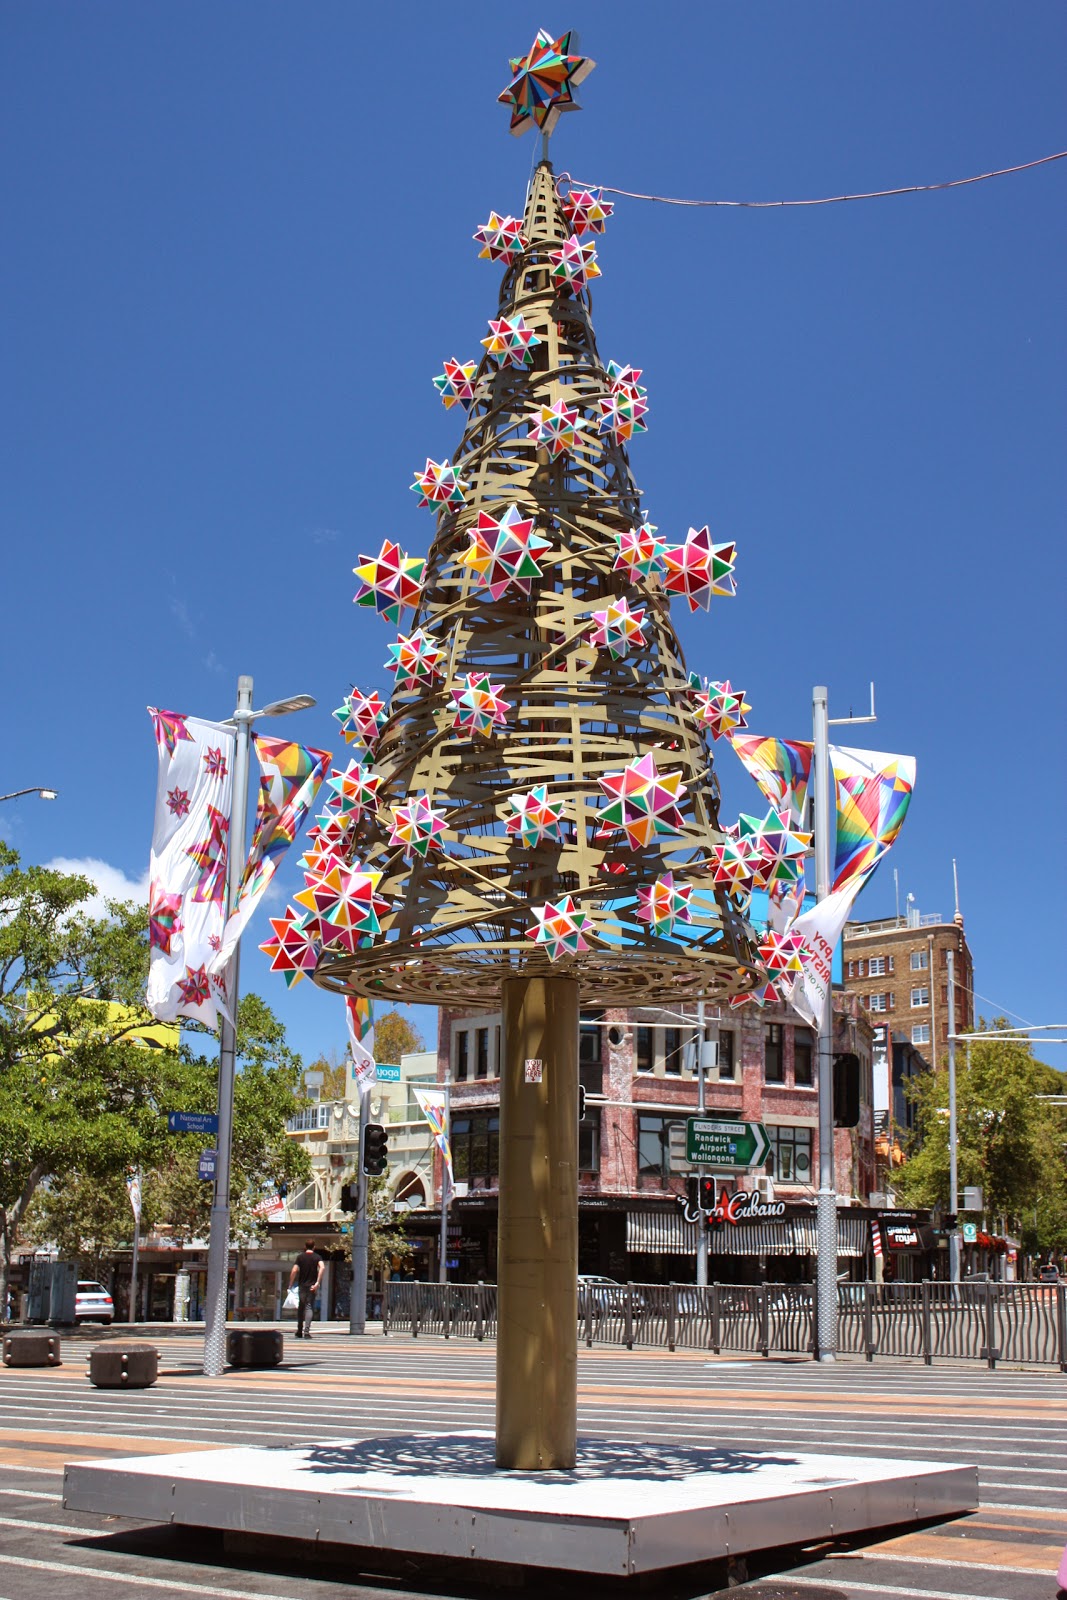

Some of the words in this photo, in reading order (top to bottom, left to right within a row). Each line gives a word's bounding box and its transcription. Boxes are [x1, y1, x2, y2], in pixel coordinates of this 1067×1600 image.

[377, 1068, 399, 1077] yoga
[179, 1114, 202, 1122] National
[187, 1122, 204, 1130] School
[694, 1123, 722, 1131] FLINDERS
[694, 1134, 731, 1143] Randwick
[699, 1143, 727, 1152] Airport
[691, 1152, 735, 1163] Wollongong
[727, 1191, 785, 1220] Cubano
[887, 1224, 911, 1236] grand
[895, 1233, 918, 1245] royal
